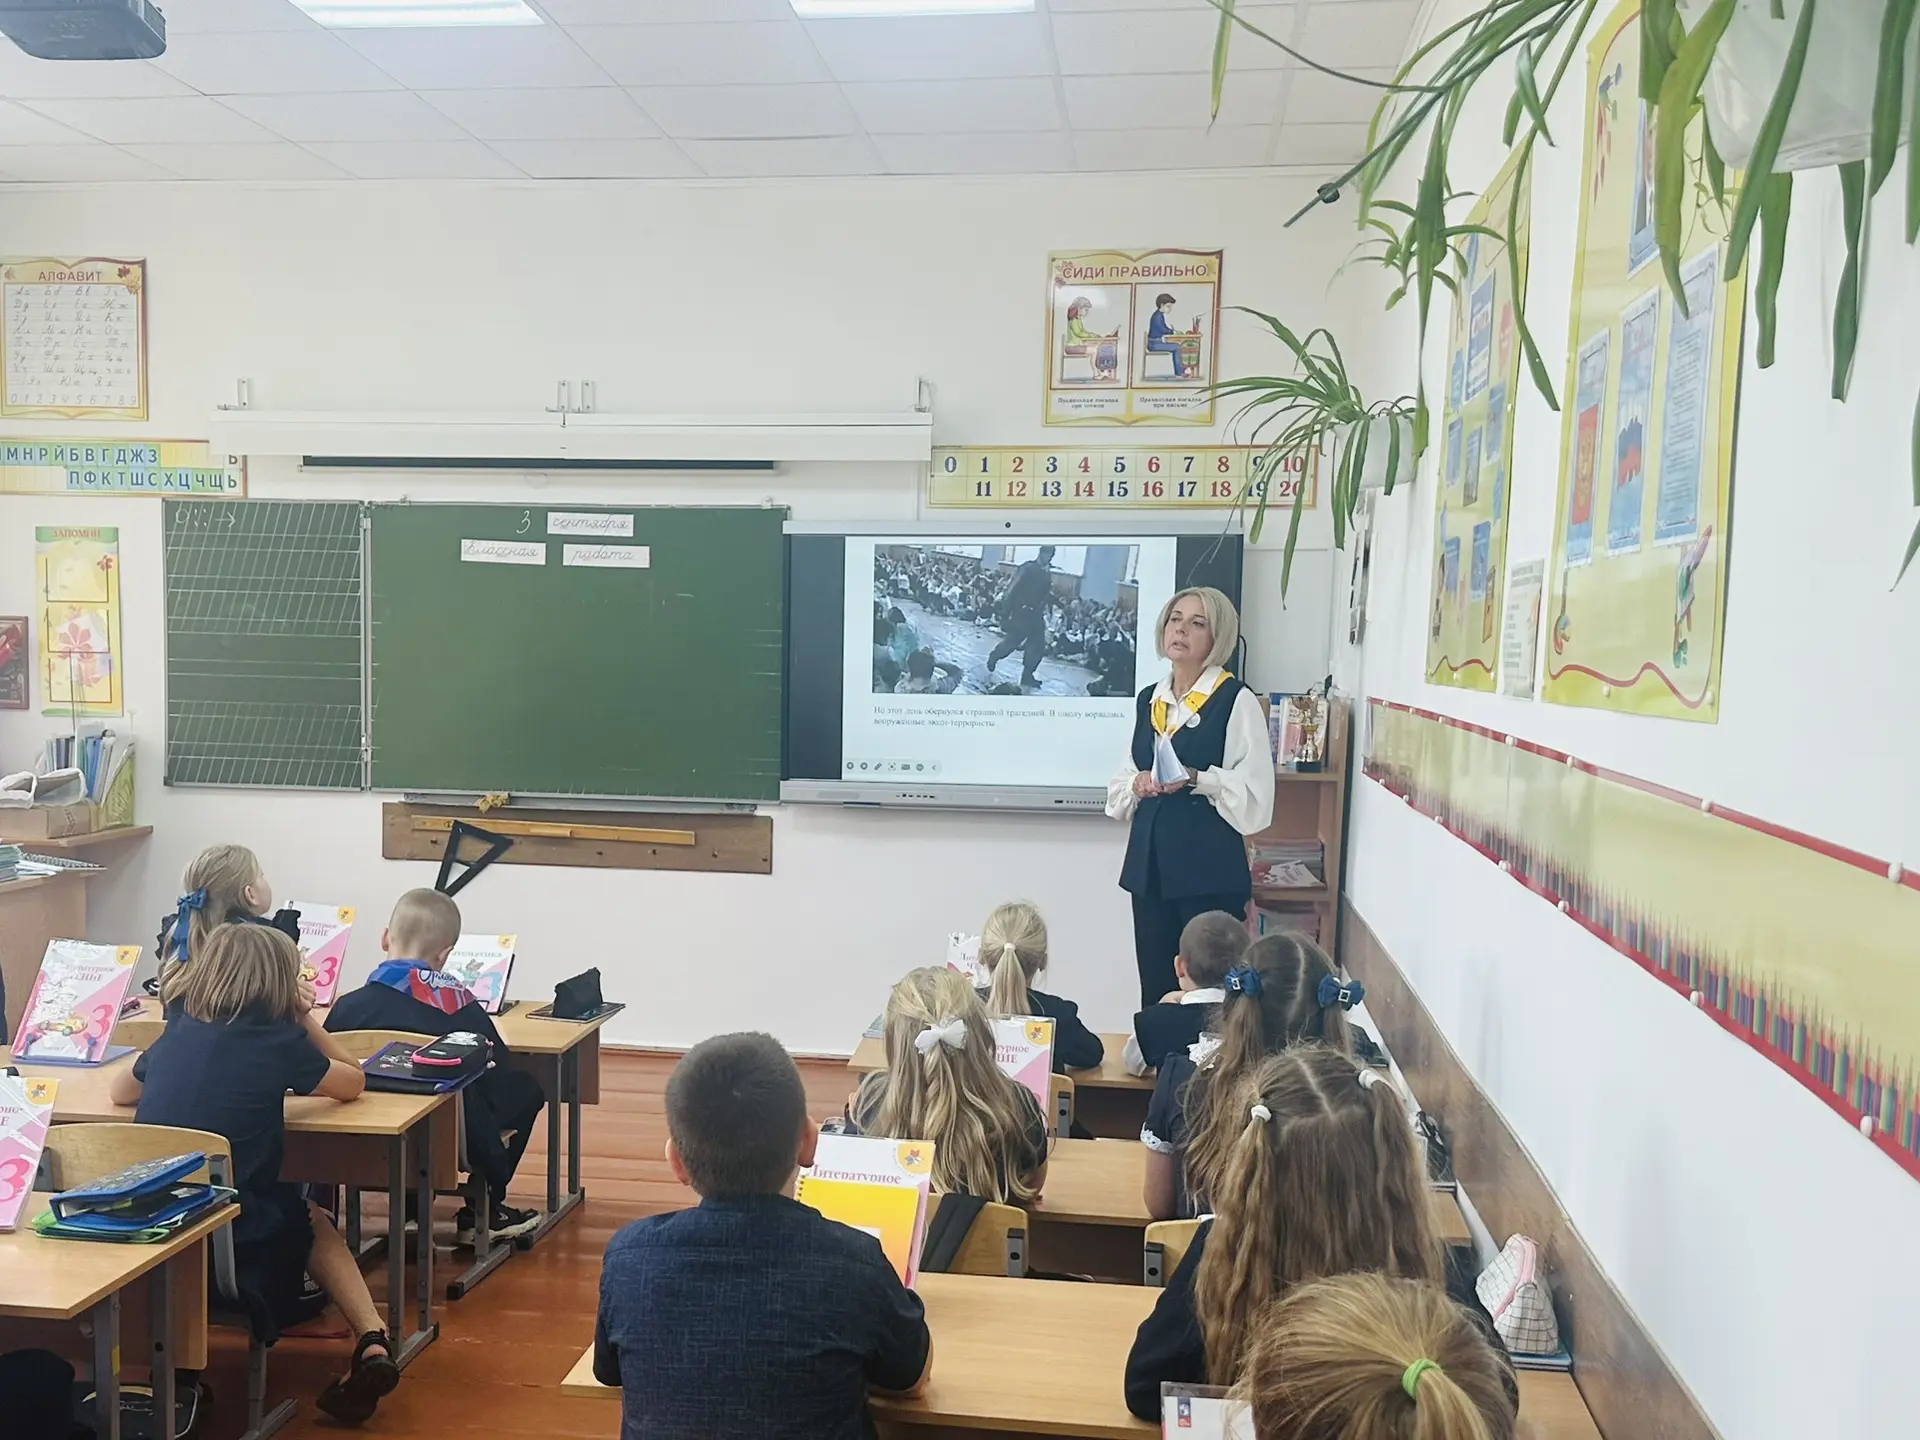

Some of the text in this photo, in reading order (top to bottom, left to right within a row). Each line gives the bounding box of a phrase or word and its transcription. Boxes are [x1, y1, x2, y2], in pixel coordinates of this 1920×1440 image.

[38, 270, 103, 282] АЛФАВИТ
[1062, 267, 1105, 279] СИДИ
[944, 456, 957, 472] 0
[980, 456, 989, 473] 1
[1012, 456, 1024, 473] 2
[1045, 456, 1058, 473] 3
[1077, 456, 1090, 473] 4
[1114, 456, 1126, 473] 5
[1147, 456, 1160, 473] 6
[1183, 456, 1195, 474] 7
[1217, 456, 1230, 474] 8
[975, 481, 992, 497] 11
[1007, 481, 1027, 497] 12
[1041, 481, 1062, 497] 13
[1073, 481, 1095, 497] 14
[1107, 481, 1129, 497] 15
[1142, 481, 1164, 498] 16
[1177, 481, 1197, 498] 17
[1210, 481, 1232, 498] 18
[516, 510, 628, 535] 3 сентября
[569, 544, 634, 566] работа
[924, 708, 963, 716] обернулся
[315, 956, 338, 987] 3
[83, 1004, 114, 1040] 3
[0, 1158, 30, 1202] 3
